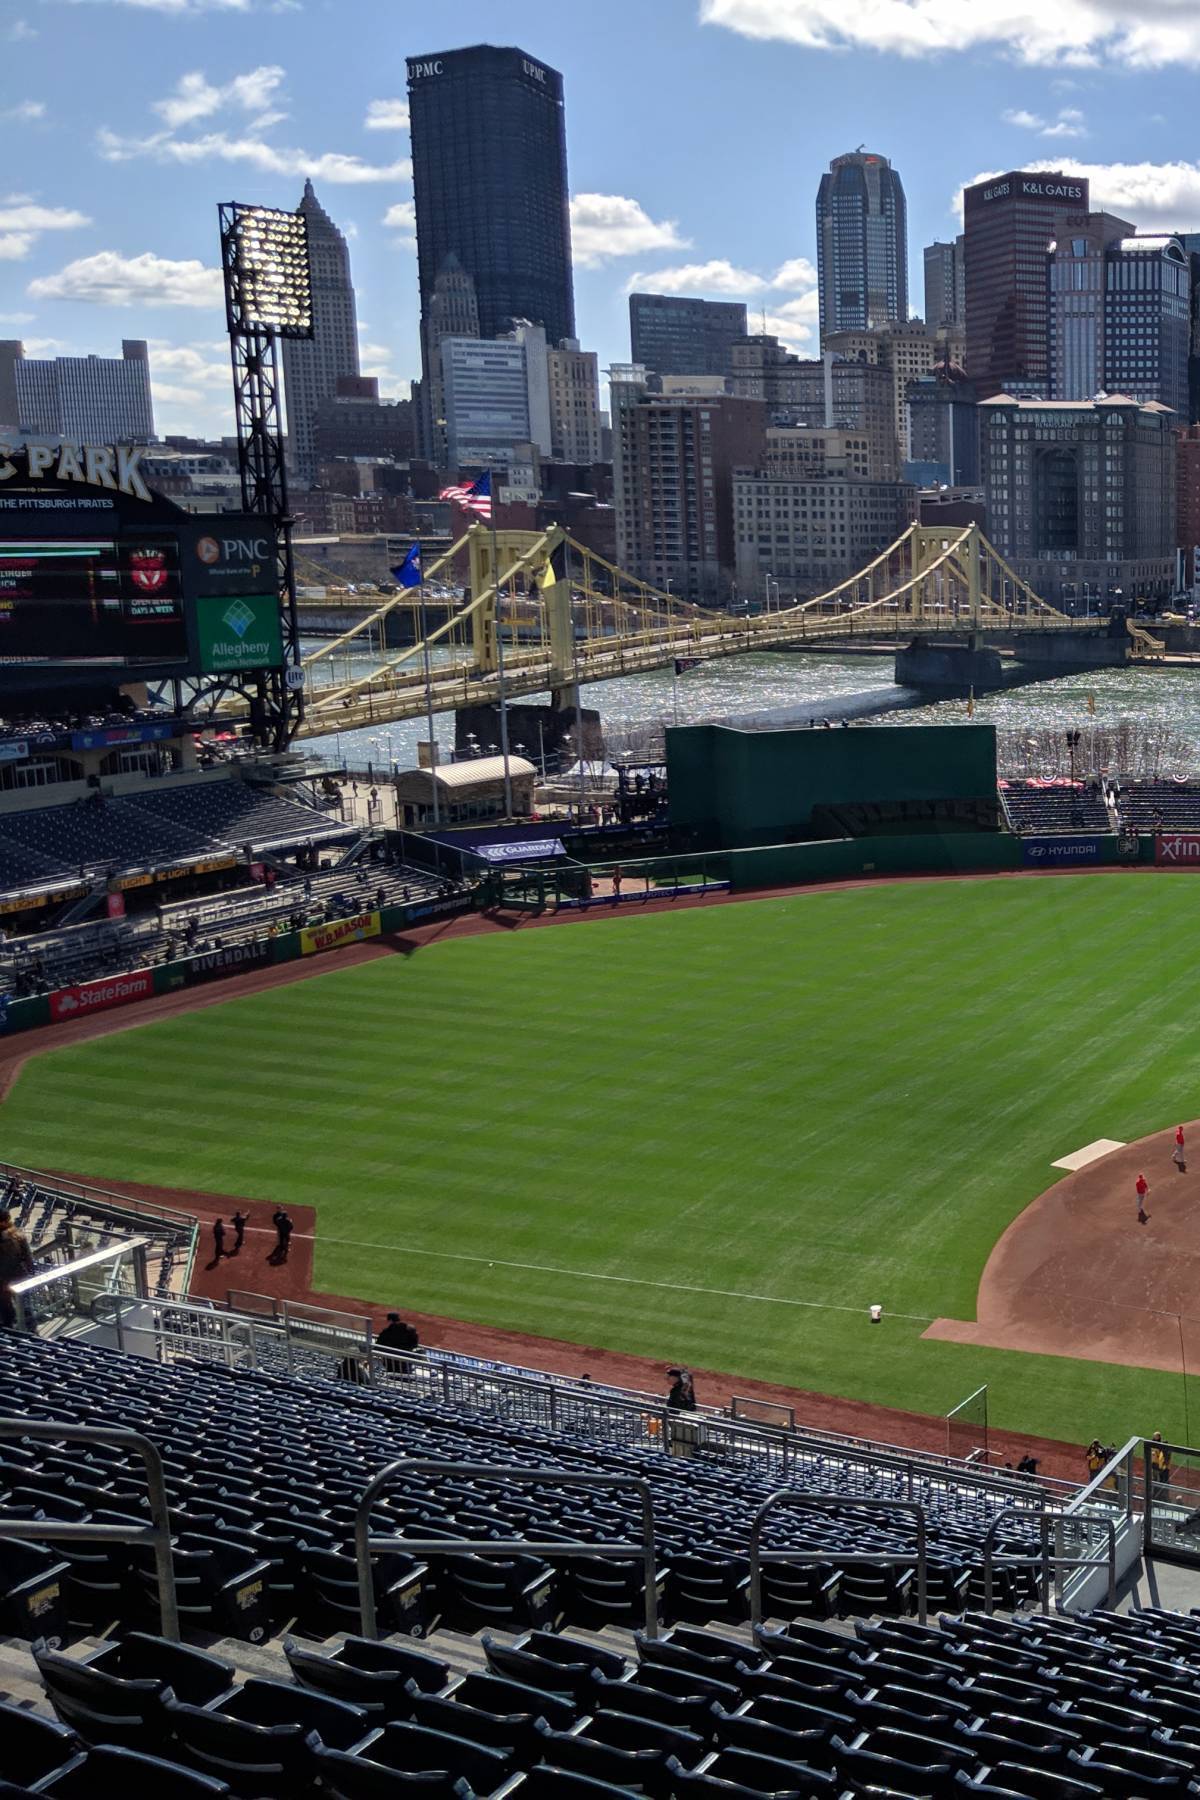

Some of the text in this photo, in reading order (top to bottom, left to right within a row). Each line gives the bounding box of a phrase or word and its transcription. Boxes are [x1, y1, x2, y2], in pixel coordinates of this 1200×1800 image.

[407, 60, 443, 80] UPMC
[522, 59, 547, 84] UPMC
[993, 183, 1010, 198] GATES
[1022, 182, 1081, 198] K&L GATES
[28, 444, 153, 503] PARK
[0, 499, 114, 509] THE PITTSBURGH PIRATES
[222, 539, 269, 560] PNC
[212, 642, 270, 657] Allegheny
[288, 670, 305, 684] Lite
[505, 843, 560, 854] GUARDIAN
[1048, 845, 1096, 856] HYUNDAI
[168, 867, 191, 879] LIGHT
[192, 942, 268, 973] RIVENDALE
